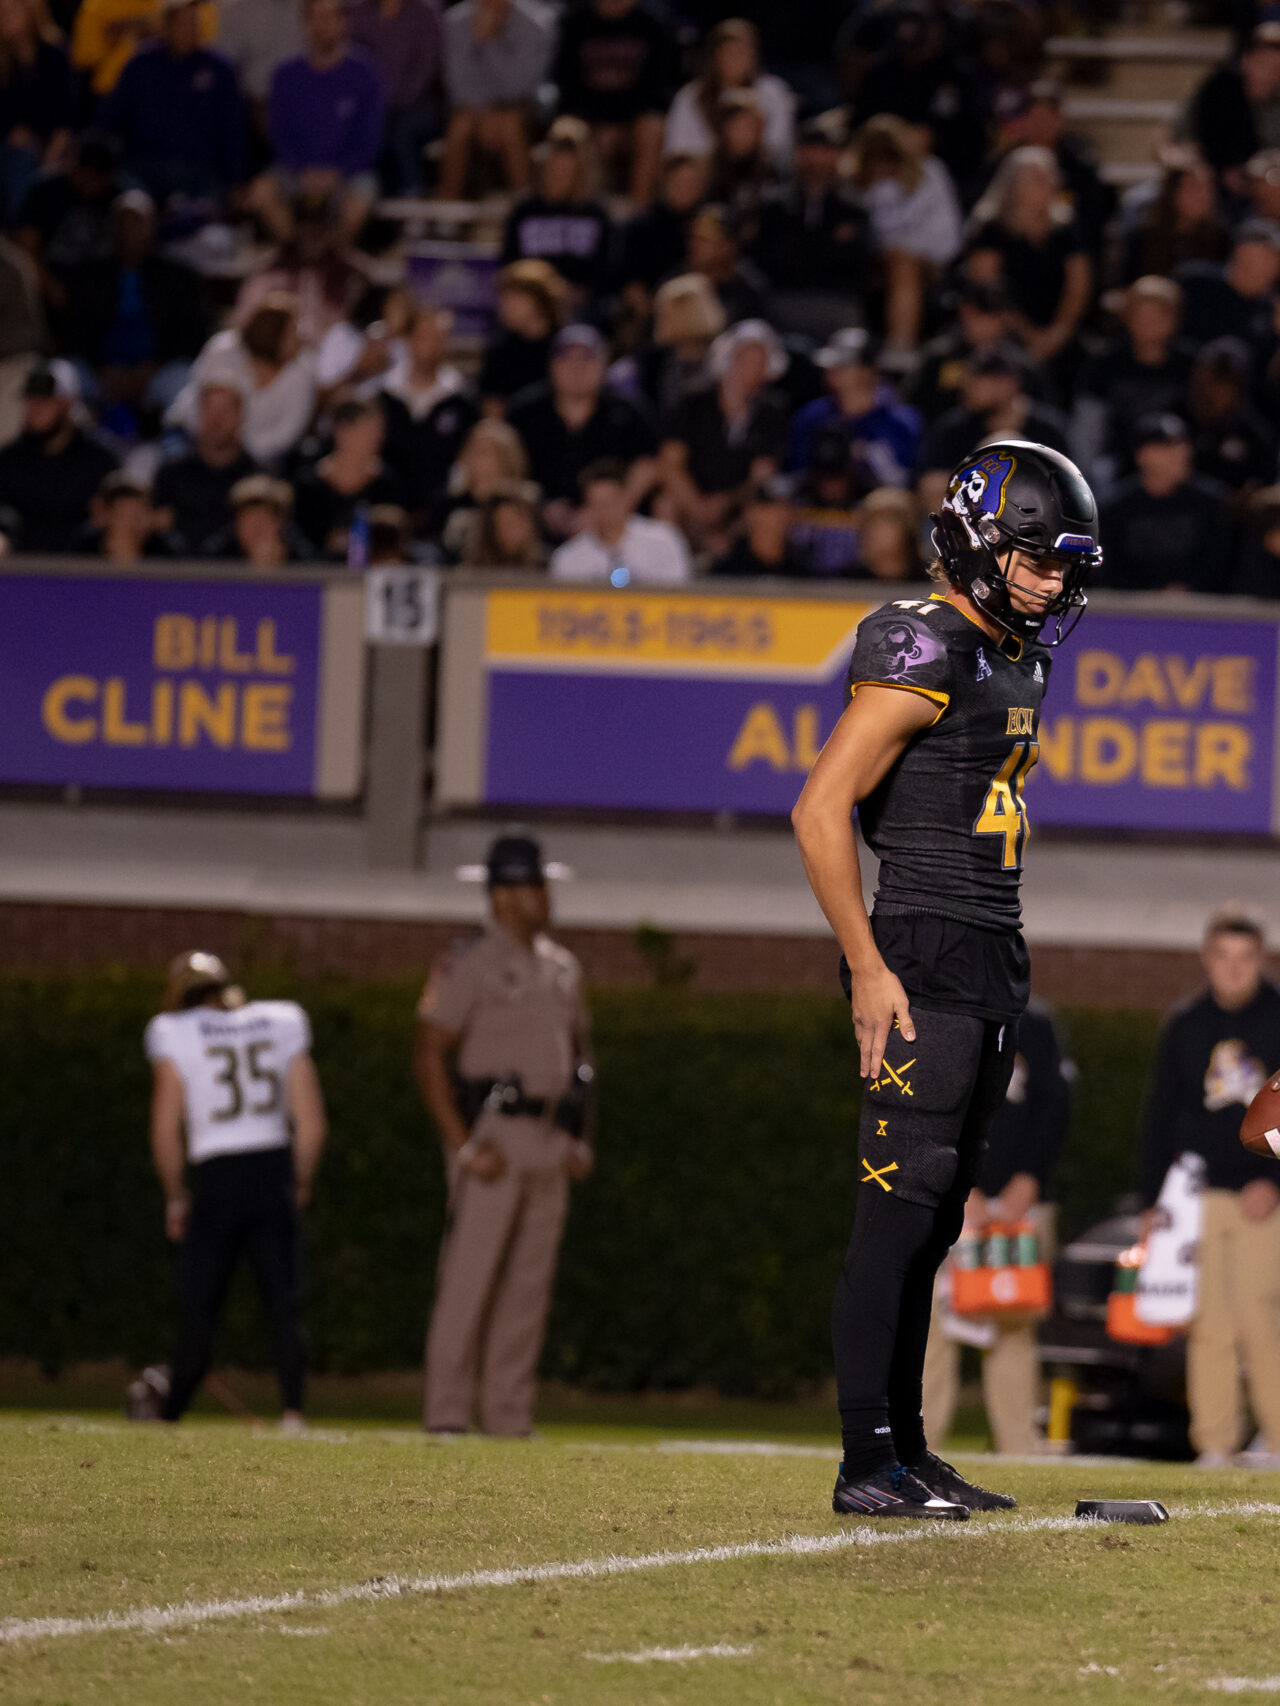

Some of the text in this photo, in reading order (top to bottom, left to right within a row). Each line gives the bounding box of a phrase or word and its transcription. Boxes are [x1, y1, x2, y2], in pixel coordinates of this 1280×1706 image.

[383, 580, 425, 630] 15
[155, 613, 295, 675] BILL
[42, 674, 292, 753] CLINE
[1077, 650, 1256, 713] DAVE
[727, 702, 1253, 791] ALNDER
[1006, 707, 1034, 735] ECU
[972, 742, 1040, 871] 41
[204, 1039, 281, 1122] 35
